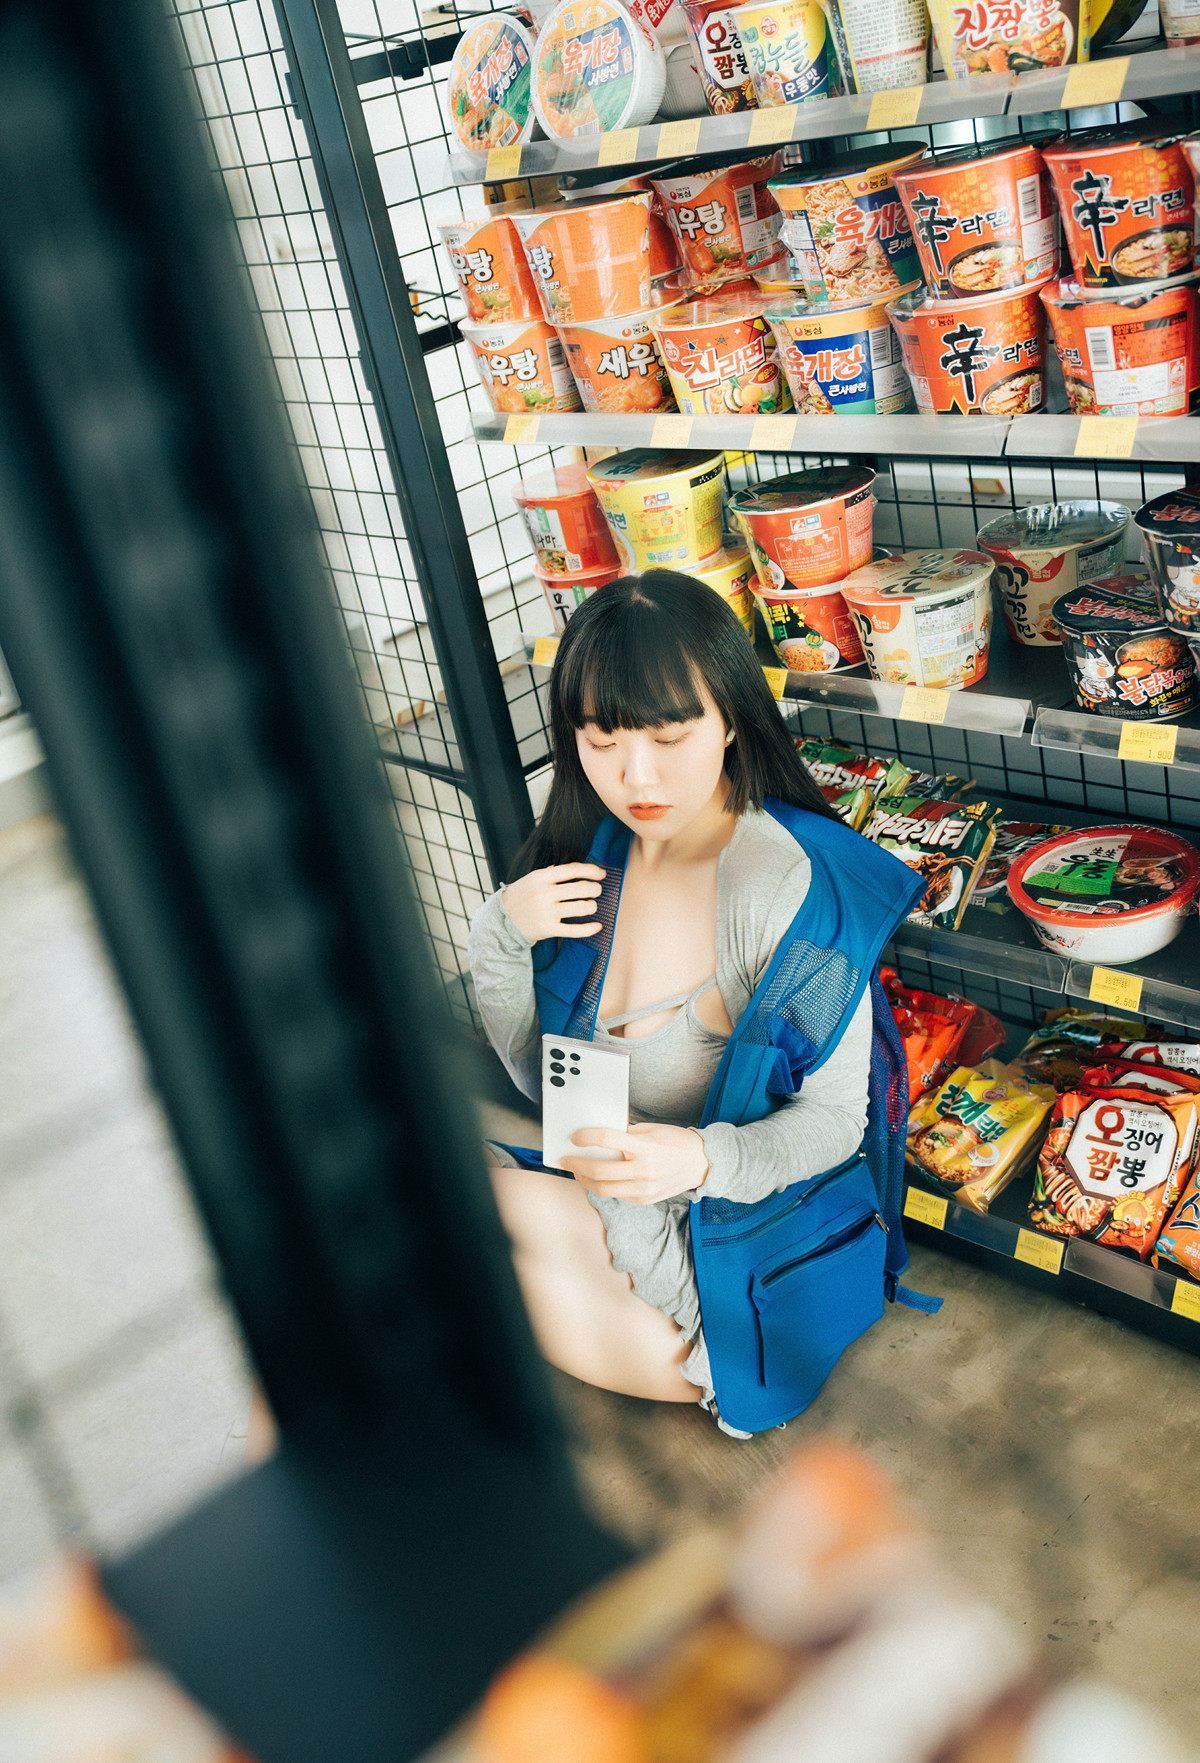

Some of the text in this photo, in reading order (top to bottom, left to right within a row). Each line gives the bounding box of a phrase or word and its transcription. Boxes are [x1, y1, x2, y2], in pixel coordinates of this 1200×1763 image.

[468, 34, 513, 107] 육개장
[564, 28, 621, 75] 육개장
[785, 67, 820, 97] 우동맛
[677, 191, 692, 200] 농심
[870, 177, 888, 190] 농심
[804, 326, 822, 336] 농심
[681, 337, 767, 391] 진라면
[785, 344, 867, 383] 육개장
[828, 382, 868, 397] 큰사발면
[997, 565, 1036, 639] 꼬꼬면
[1116, 666, 1193, 705] 불닭볶음면
[1148, 748, 1173, 760] 1.900
[1115, 995, 1138, 1009] 2.500
[936, 1083, 1010, 1142] 참깨라면
[1084, 1105, 1164, 1154] 오징어
[1128, 1117, 1163, 1129] 역시 오징어!
[1086, 1147, 1147, 1188] 짬뽕
[1169, 1191, 1200, 1229] 스
